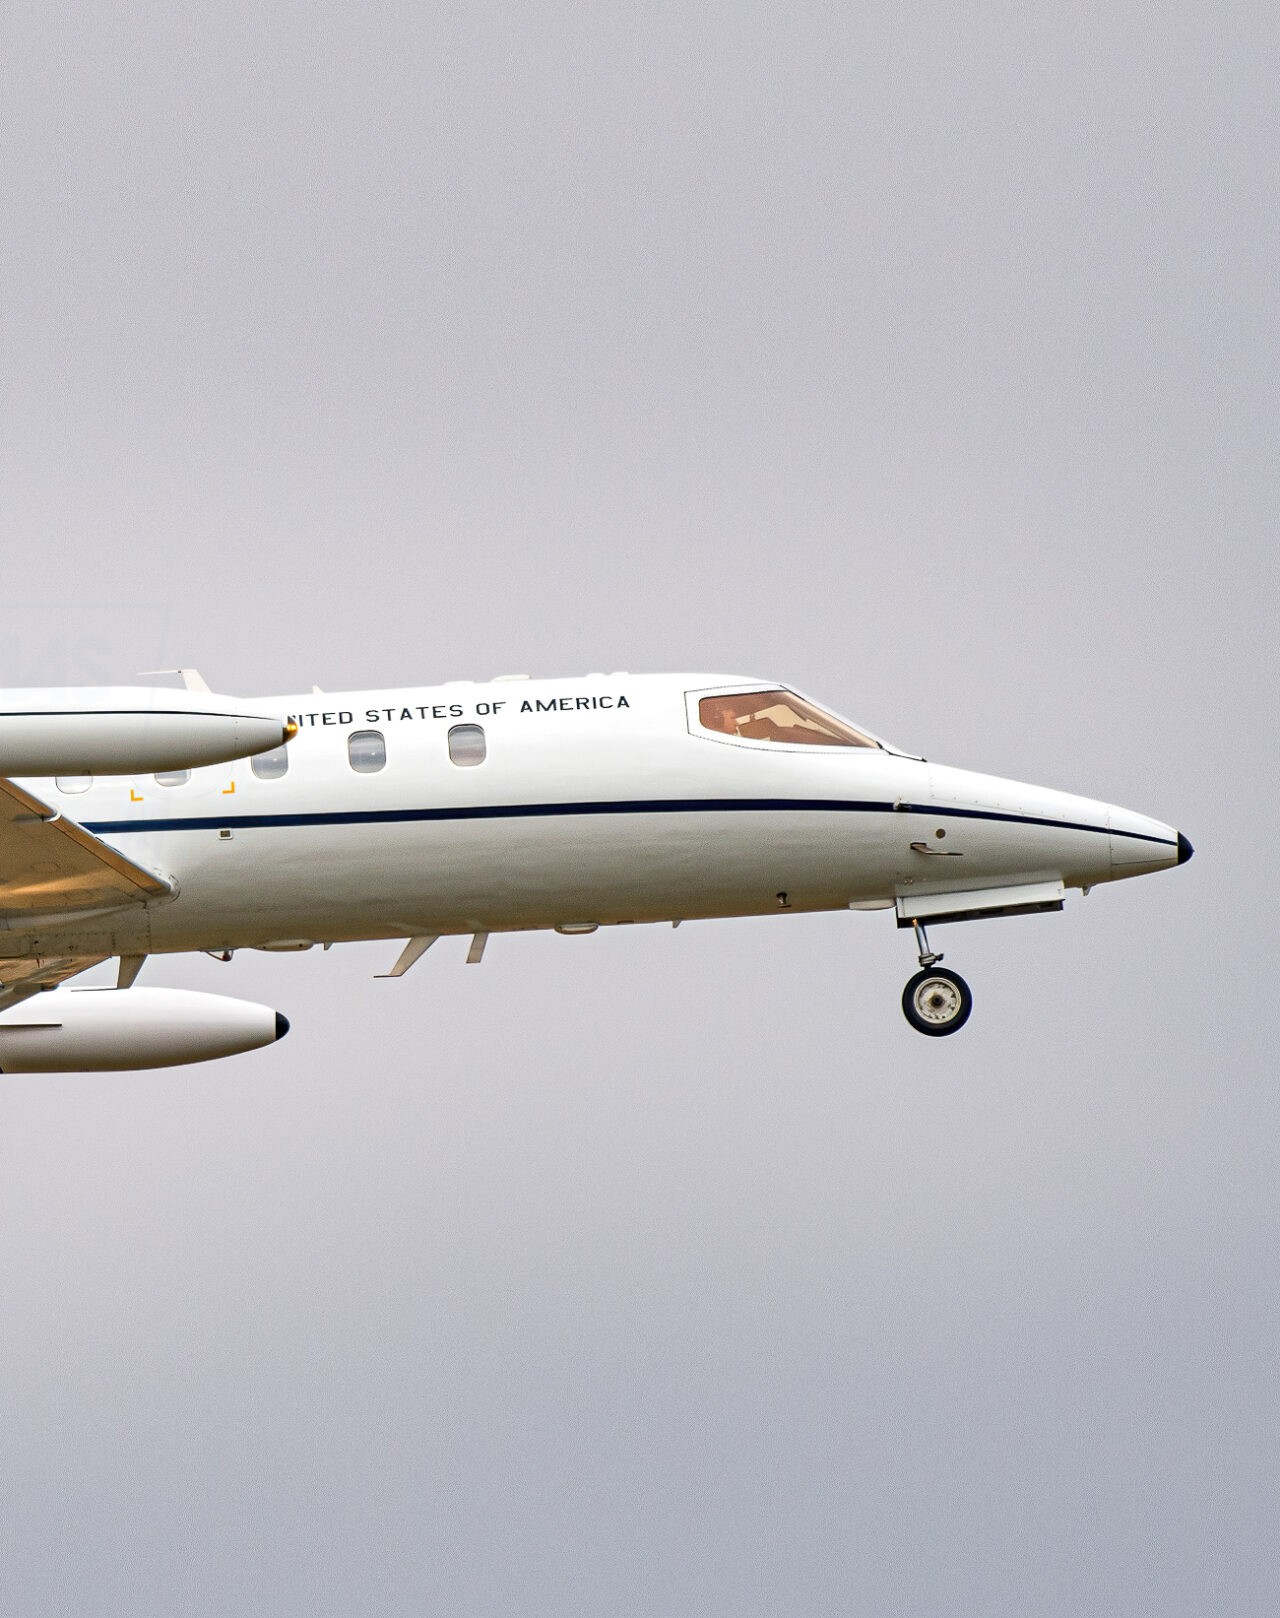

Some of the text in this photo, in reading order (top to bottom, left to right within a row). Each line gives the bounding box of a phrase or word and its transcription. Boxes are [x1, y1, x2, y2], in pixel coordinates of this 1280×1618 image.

[290, 696, 630, 727] ITED STATES OF AMERICA
